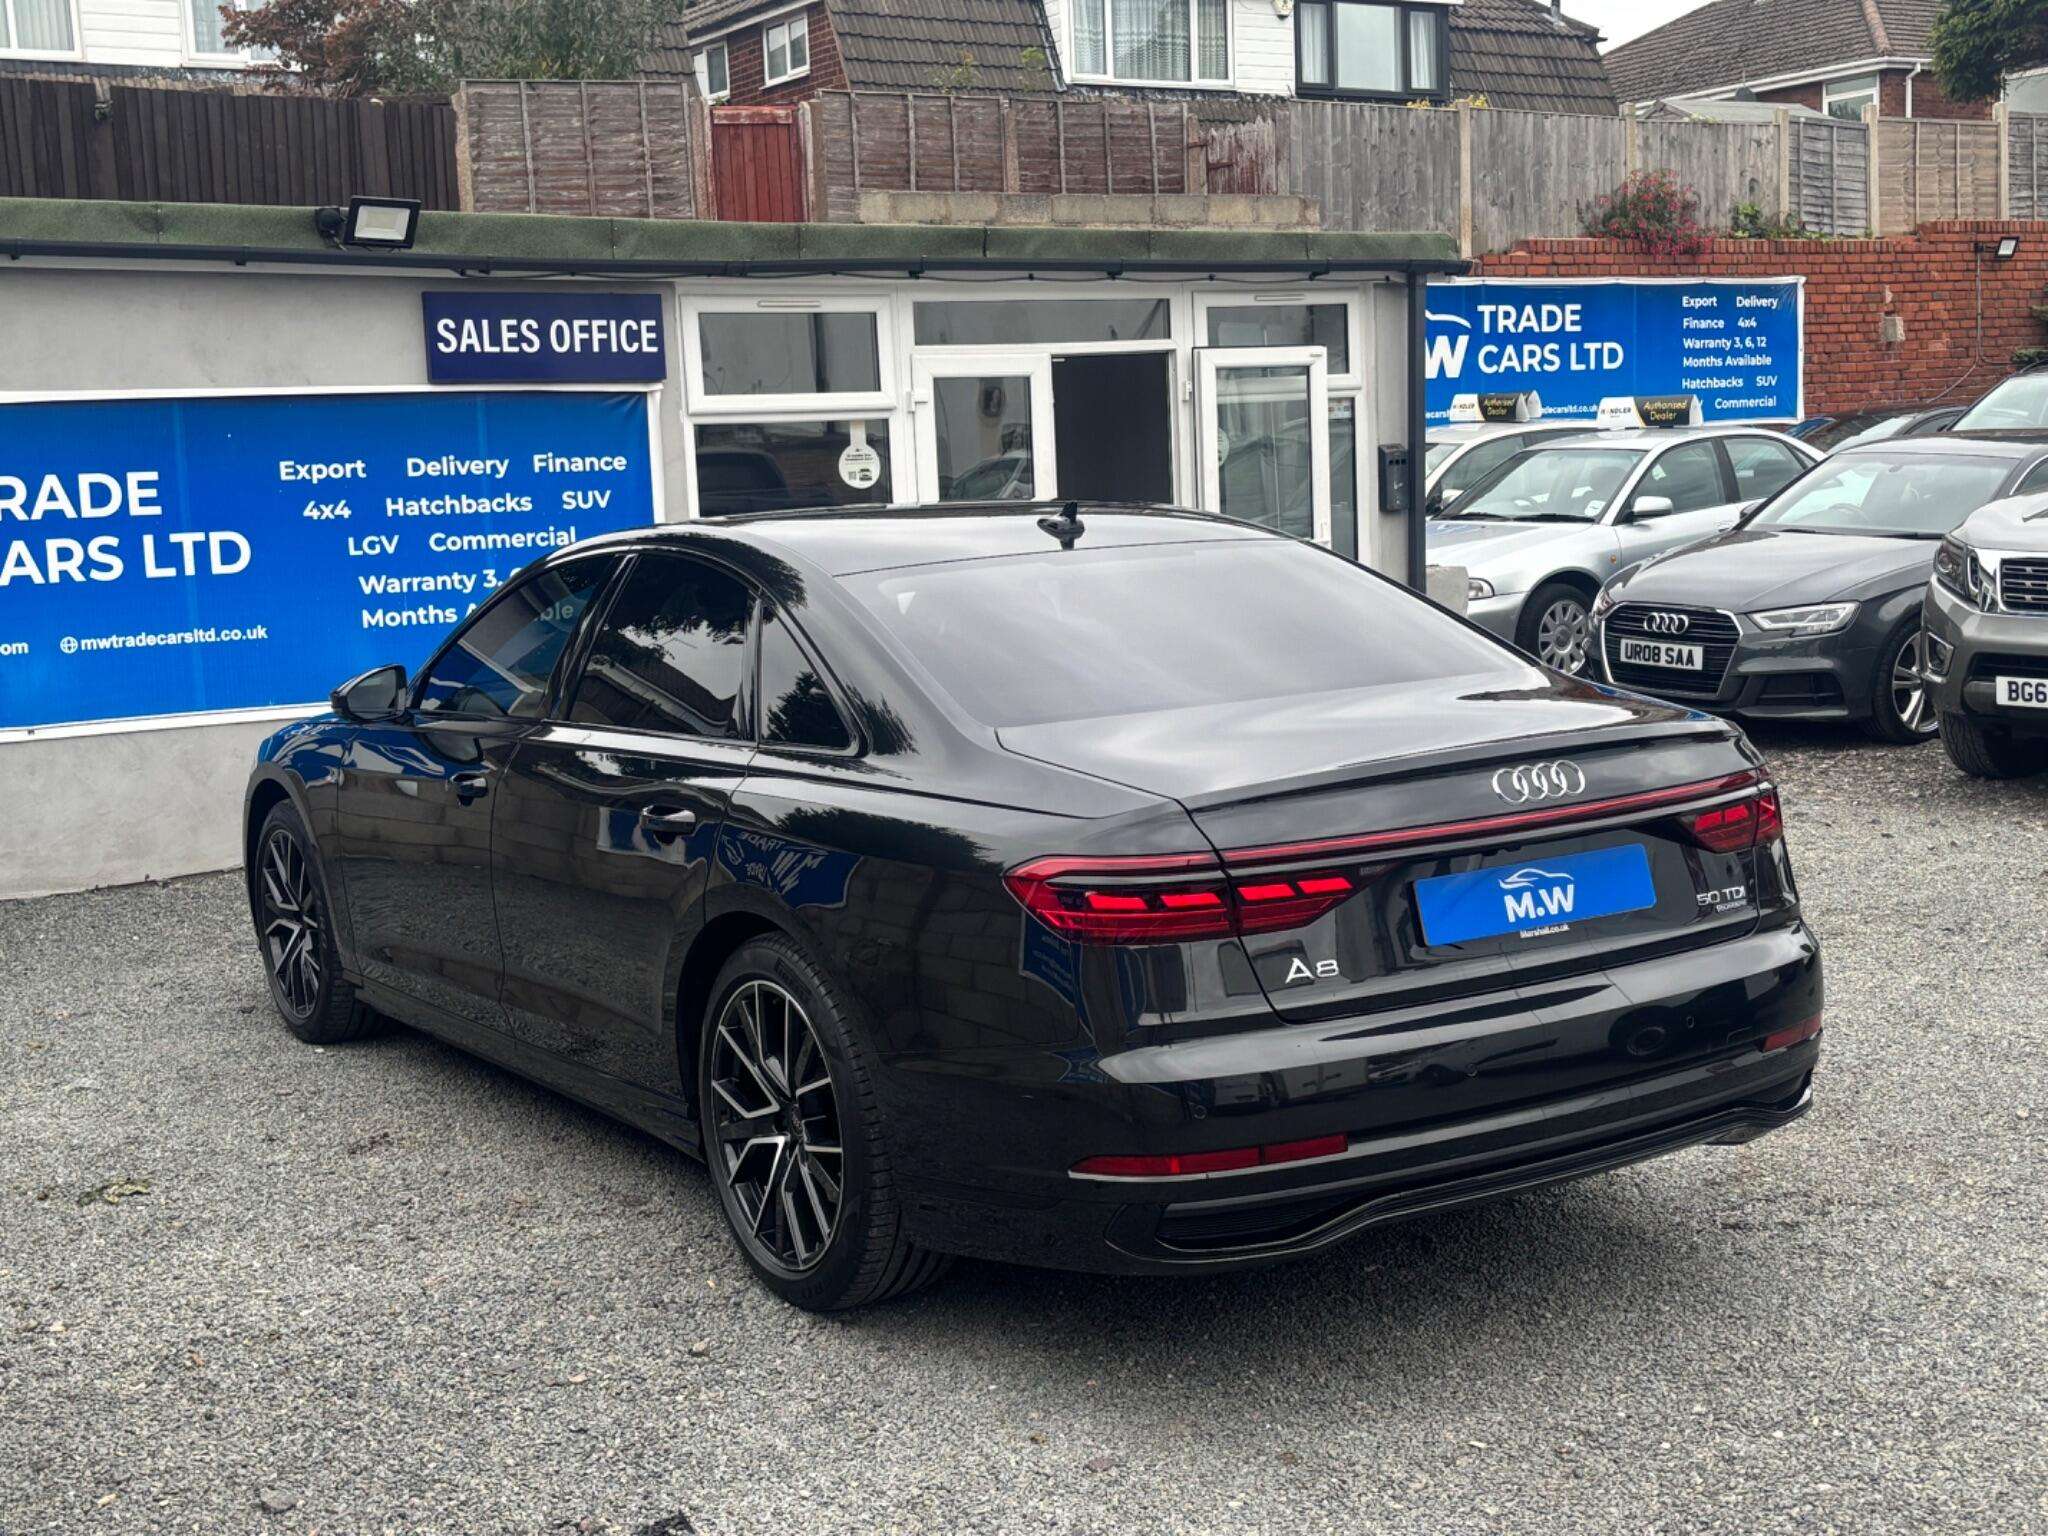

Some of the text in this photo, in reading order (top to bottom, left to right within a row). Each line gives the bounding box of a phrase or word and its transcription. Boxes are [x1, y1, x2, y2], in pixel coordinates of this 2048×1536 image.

[1682, 295, 1778, 310] Export Delivery
[1476, 303, 1582, 334] TRADE
[1683, 316, 1758, 329] Finance 4x4
[436, 318, 659, 354] SALES OFFICE
[1683, 336, 1767, 351] Warranty 3, 6, 12
[1477, 342, 1625, 374] CARS LTD
[1683, 353, 1772, 368] Months Available
[1681, 375, 1778, 390] Hatchbacks SUV
[1714, 395, 1777, 410] Commercial
[279, 451, 628, 484] Export Delivery Finance
[0, 471, 163, 522] RADE
[303, 489, 611, 520] 4x4 Hatchbacks SUV
[347, 526, 577, 556] LGV Commercial
[0, 530, 252, 587] ARS LTD
[358, 571, 477, 594] Warranty
[362, 602, 458, 629] Months
[80, 624, 268, 651] mwtradecarsltd.co.uk
[1625, 641, 1695, 668] UR08 SAA
[2007, 680, 2047, 703] BG6
[1504, 883, 1575, 923] M.W
[1696, 890, 1720, 906] 50
[1721, 885, 1746, 901] TDI
[1285, 957, 1340, 984] A8
